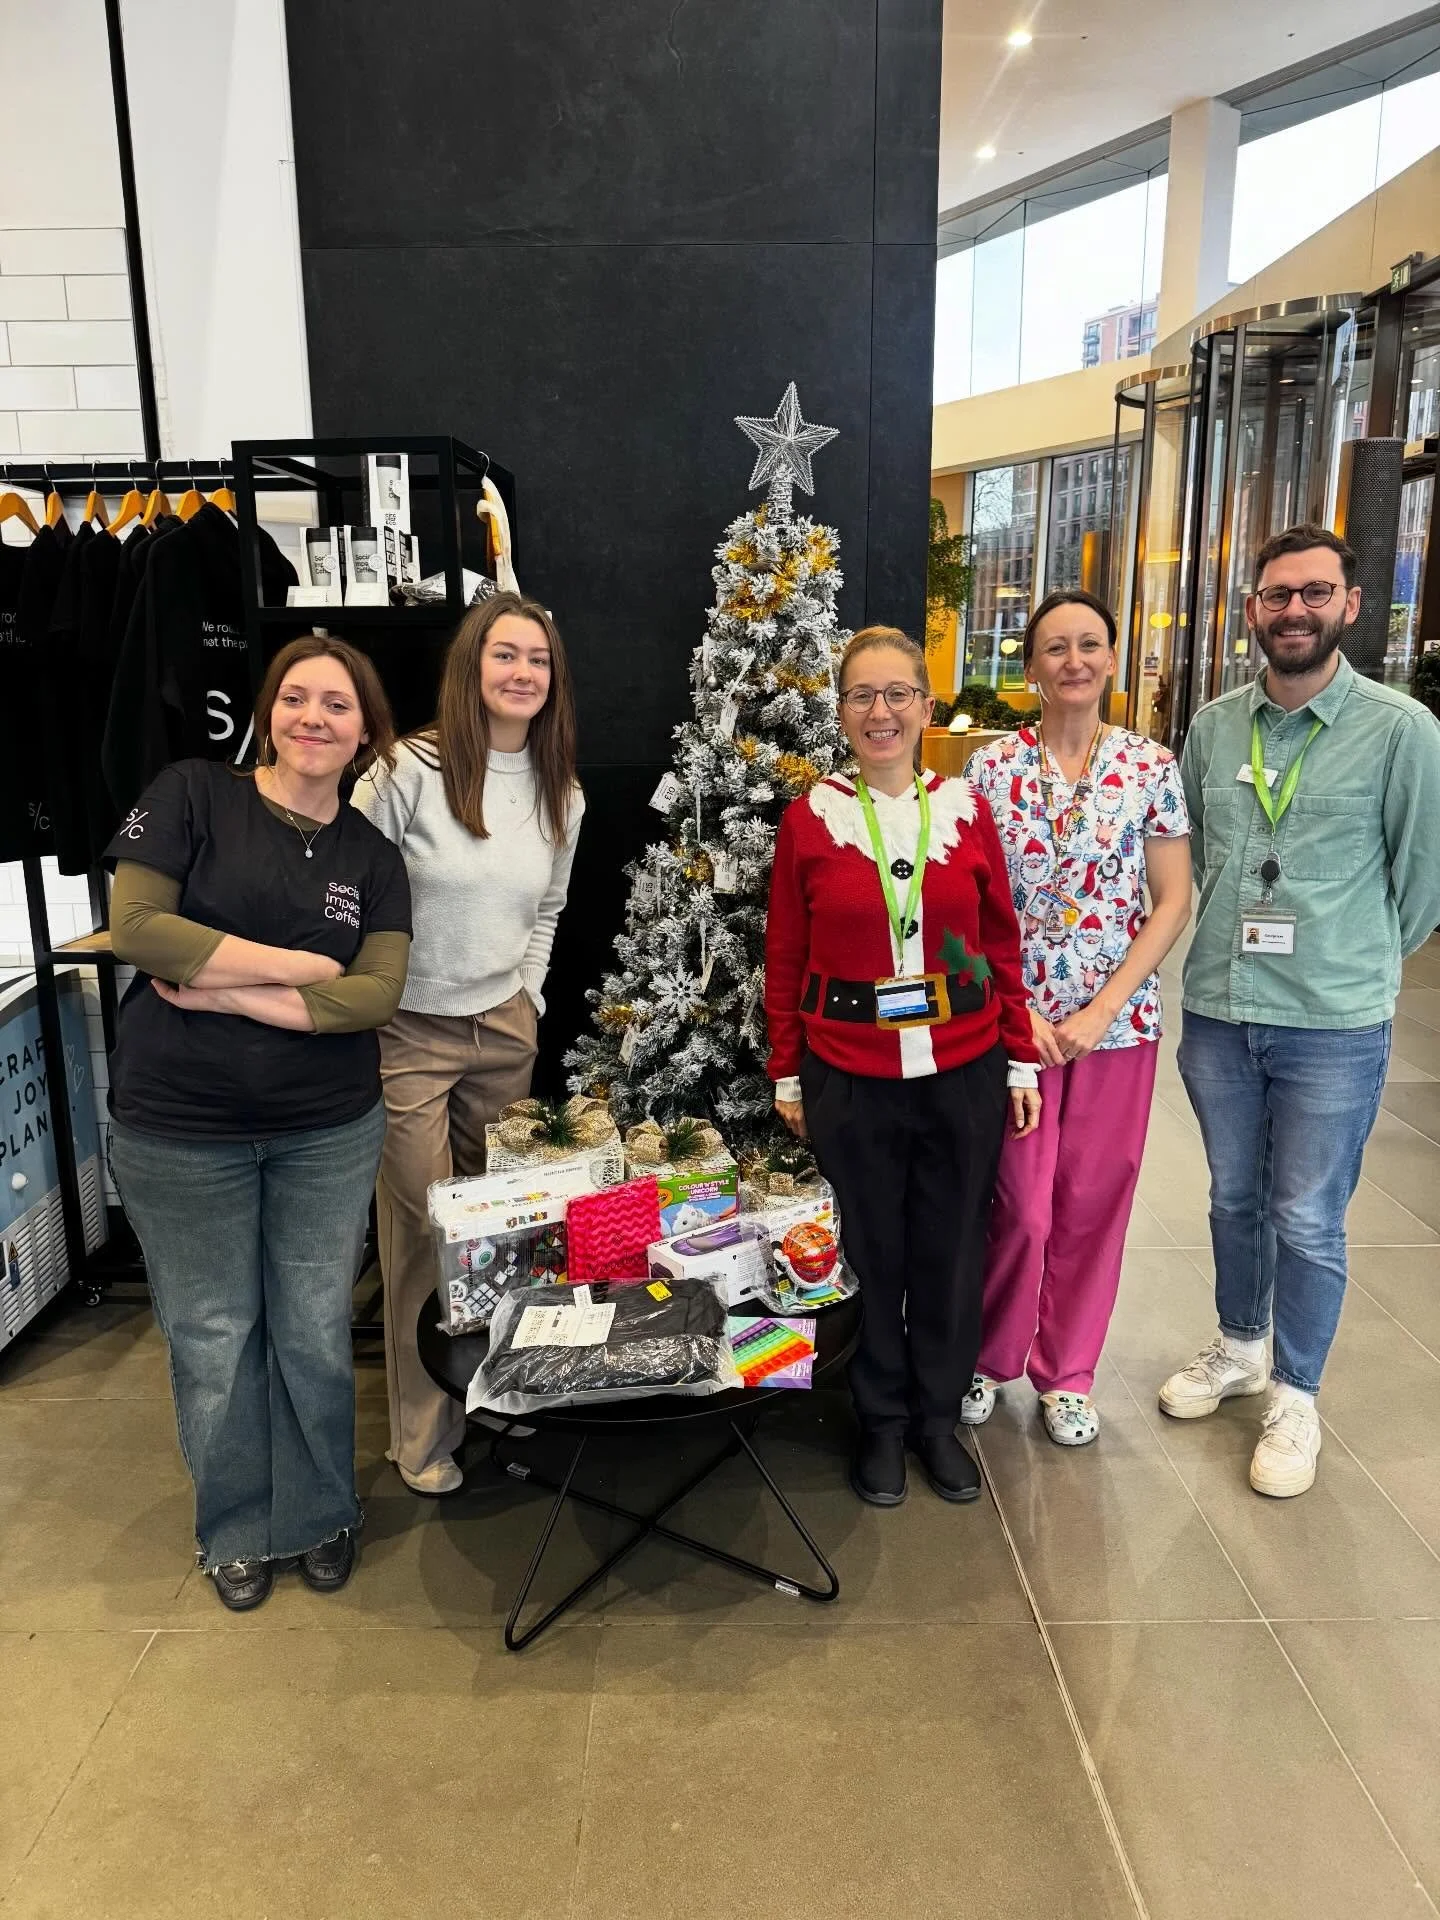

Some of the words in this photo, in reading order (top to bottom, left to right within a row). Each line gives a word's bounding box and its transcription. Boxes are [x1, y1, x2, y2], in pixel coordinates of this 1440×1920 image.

[664, 786, 676, 801] £10
[119, 808, 149, 839] S/C
[329, 882, 360, 901] Socia
[325, 892, 361, 916] Impac
[14, 1072, 48, 1115] JOY
[678, 1183, 704, 1192] COLOUR
[710, 1179, 730, 1188] STYLE
[690, 1186, 719, 1195] UNICORN
